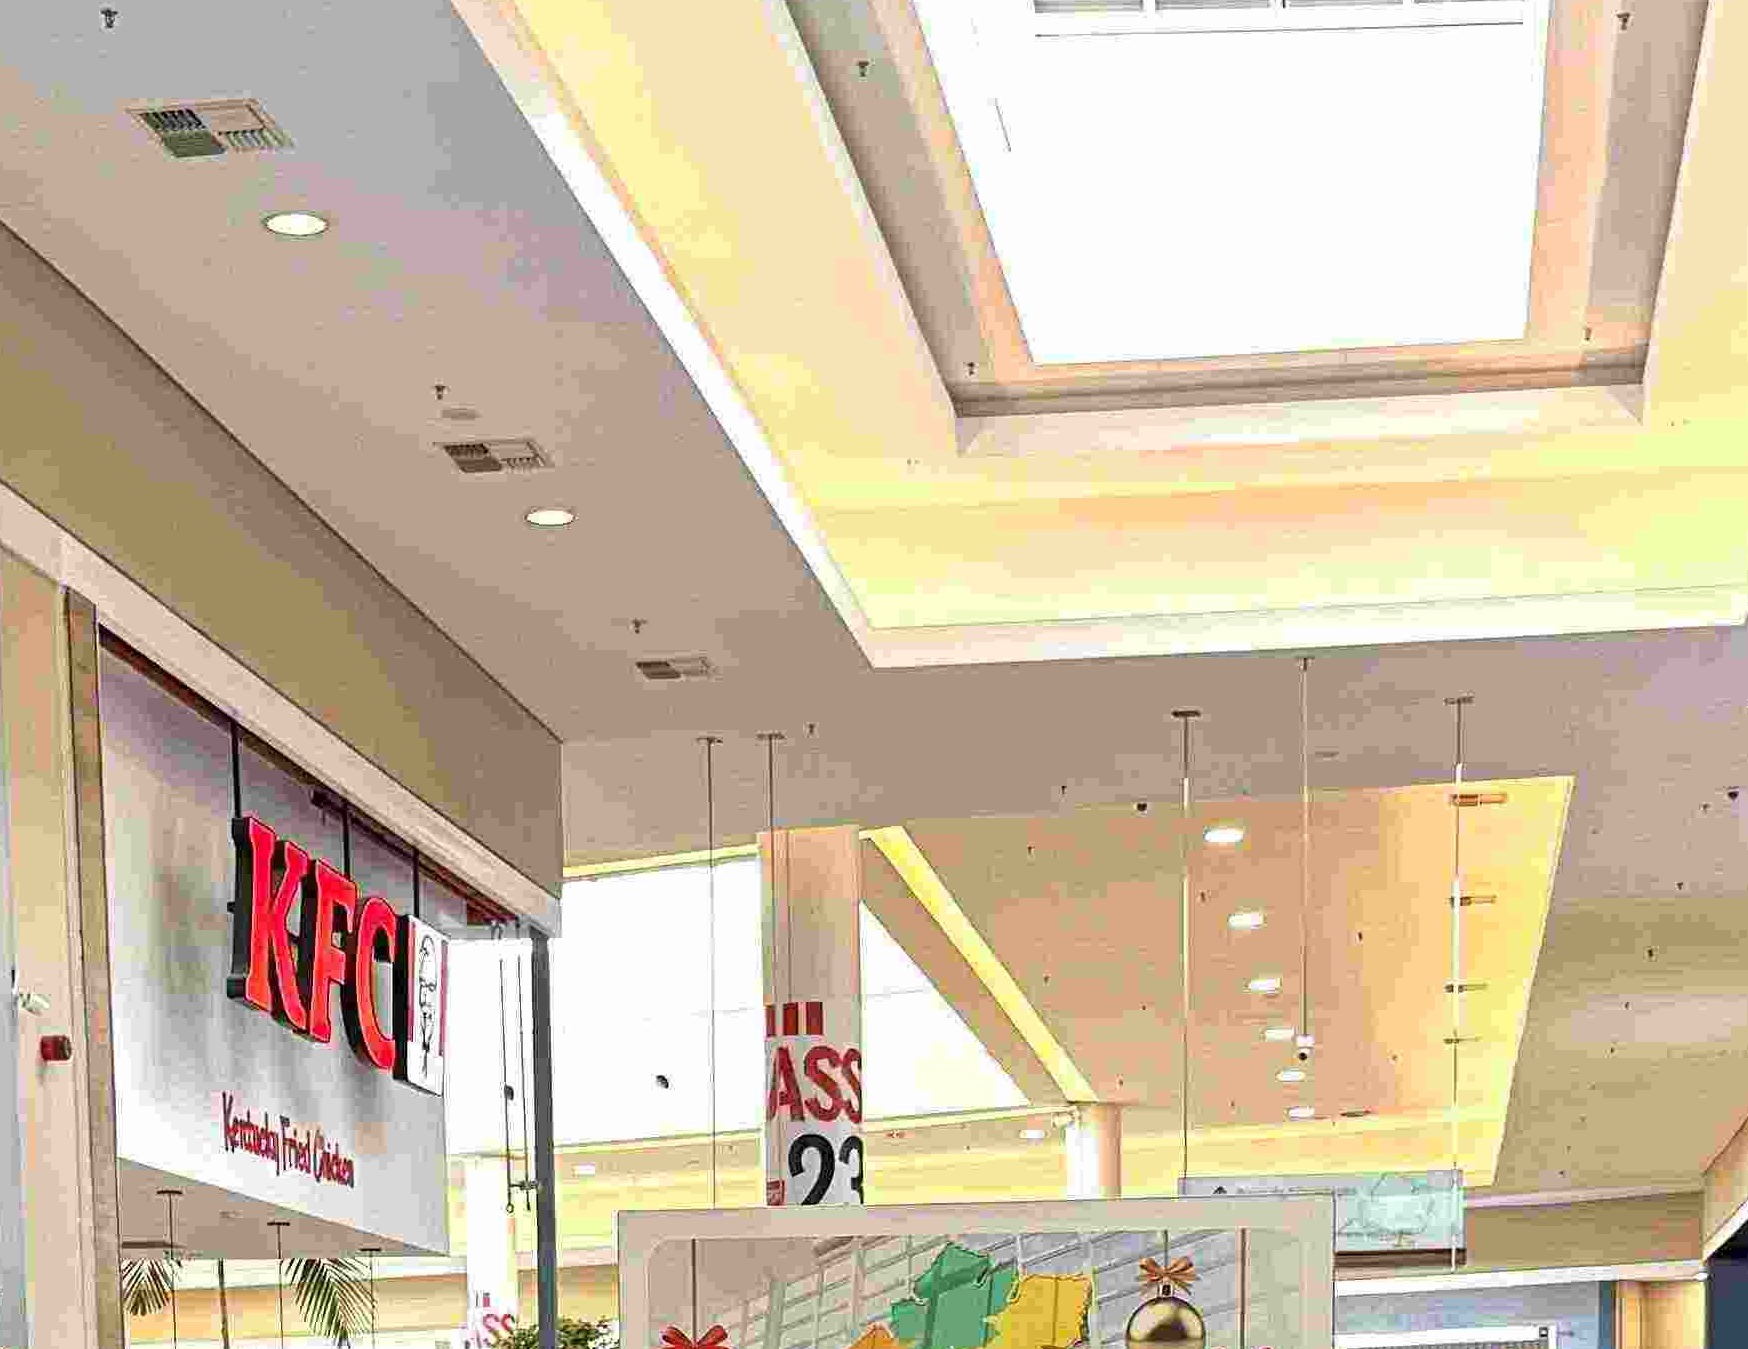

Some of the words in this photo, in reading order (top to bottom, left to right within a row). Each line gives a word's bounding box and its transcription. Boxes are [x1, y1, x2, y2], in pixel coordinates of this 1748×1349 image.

[243, 816, 398, 1071] KFC
[221, 1090, 280, 1177] Kentucky
[278, 1114, 311, 1175] Fried
[310, 1126, 355, 1189] Chicken
